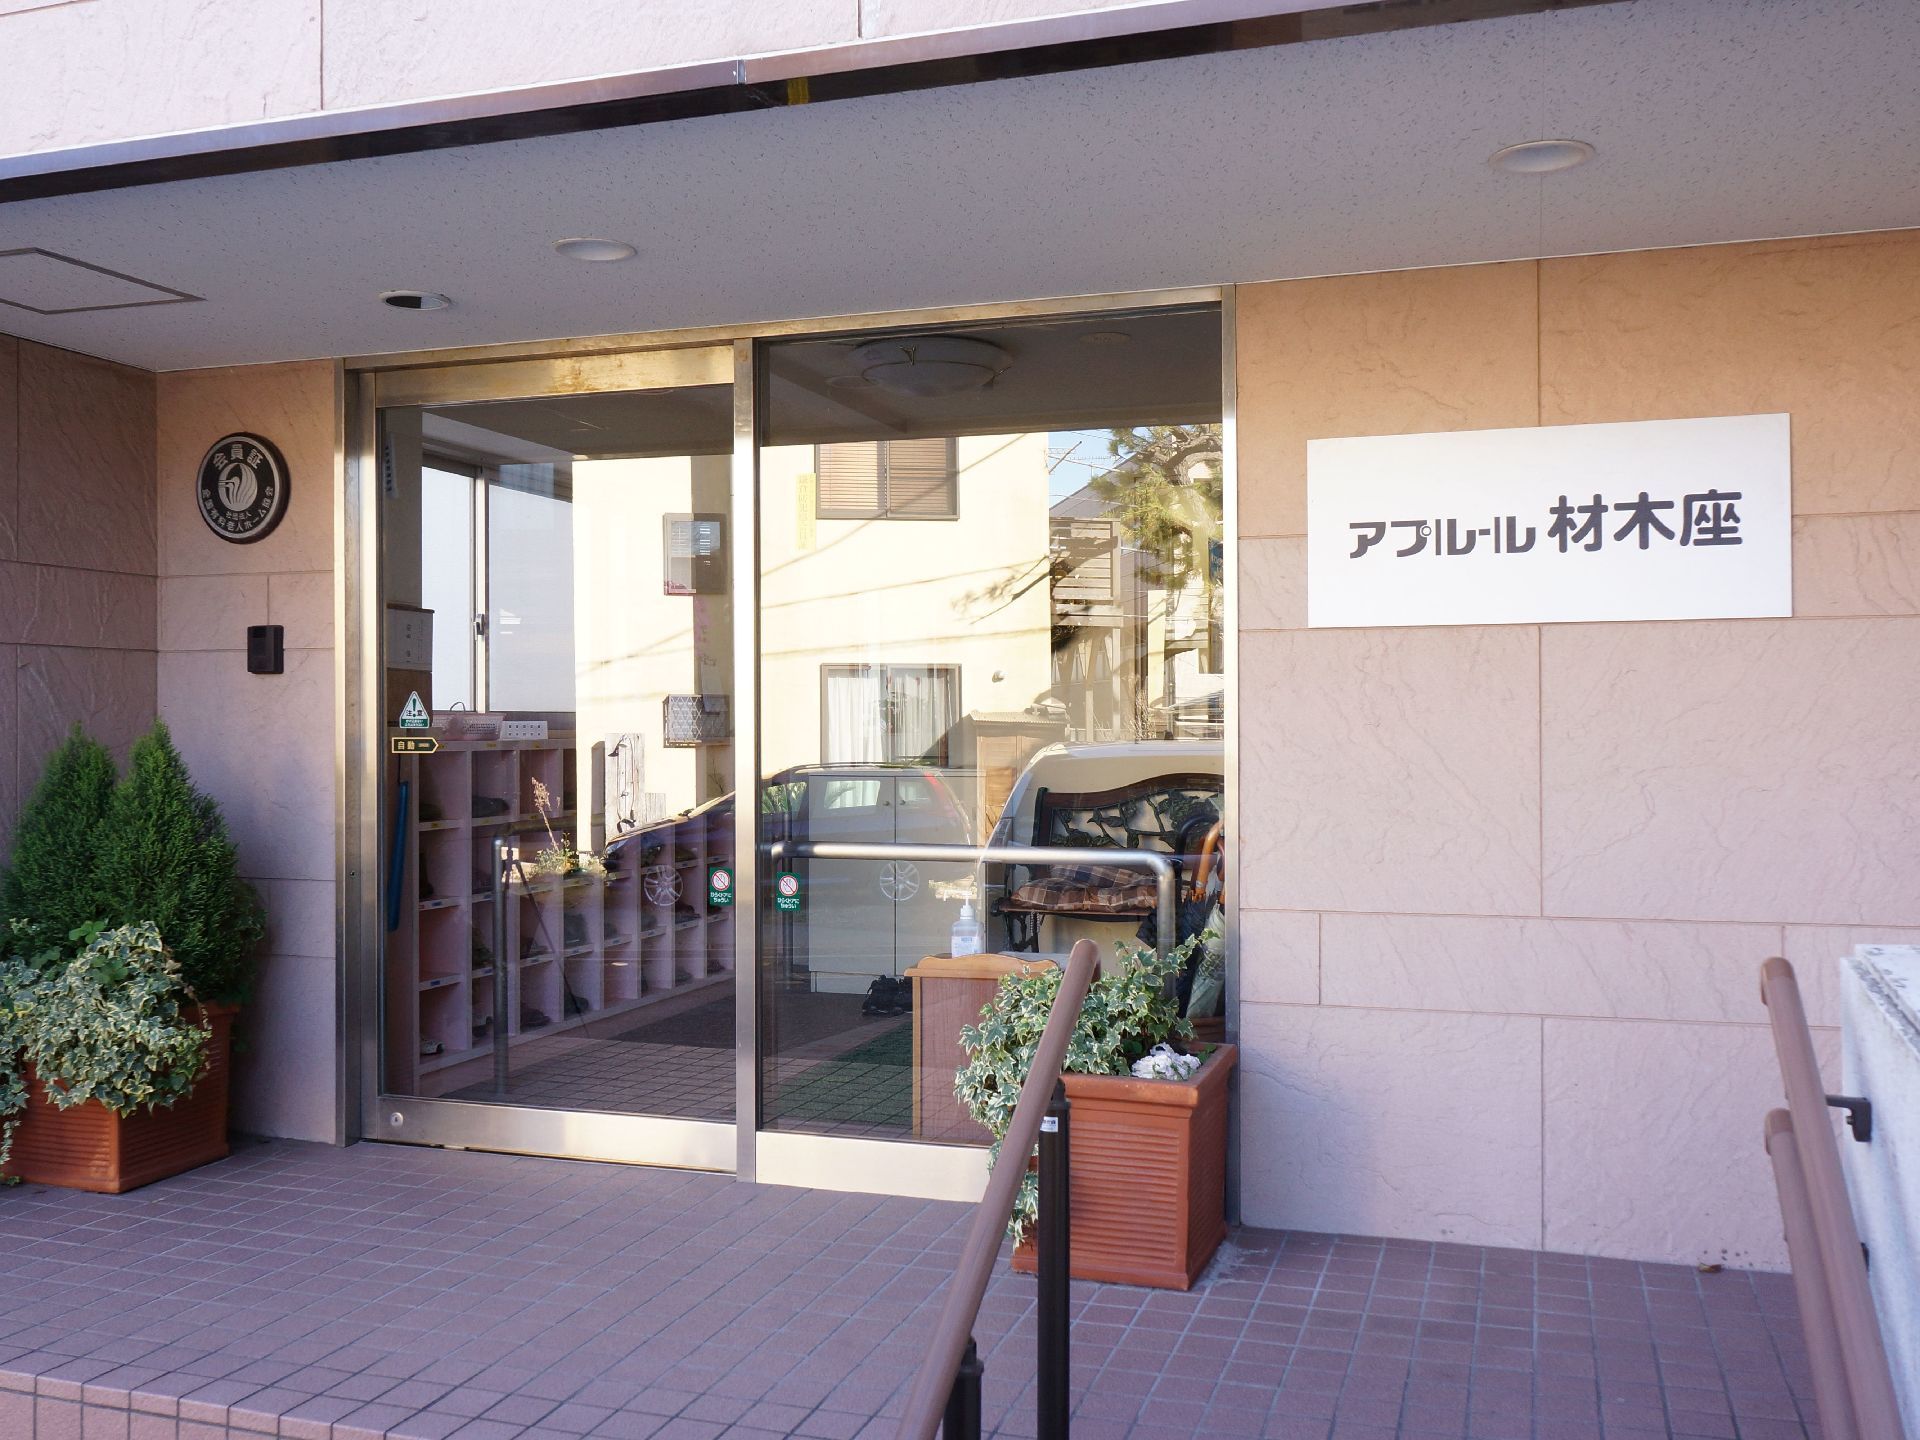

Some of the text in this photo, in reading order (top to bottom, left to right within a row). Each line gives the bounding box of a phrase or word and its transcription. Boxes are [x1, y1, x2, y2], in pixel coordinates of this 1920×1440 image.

[212, 443, 264, 470] 会員証
[1348, 488, 1743, 559] アプルール材木座
[397, 740, 415, 750] 自動
